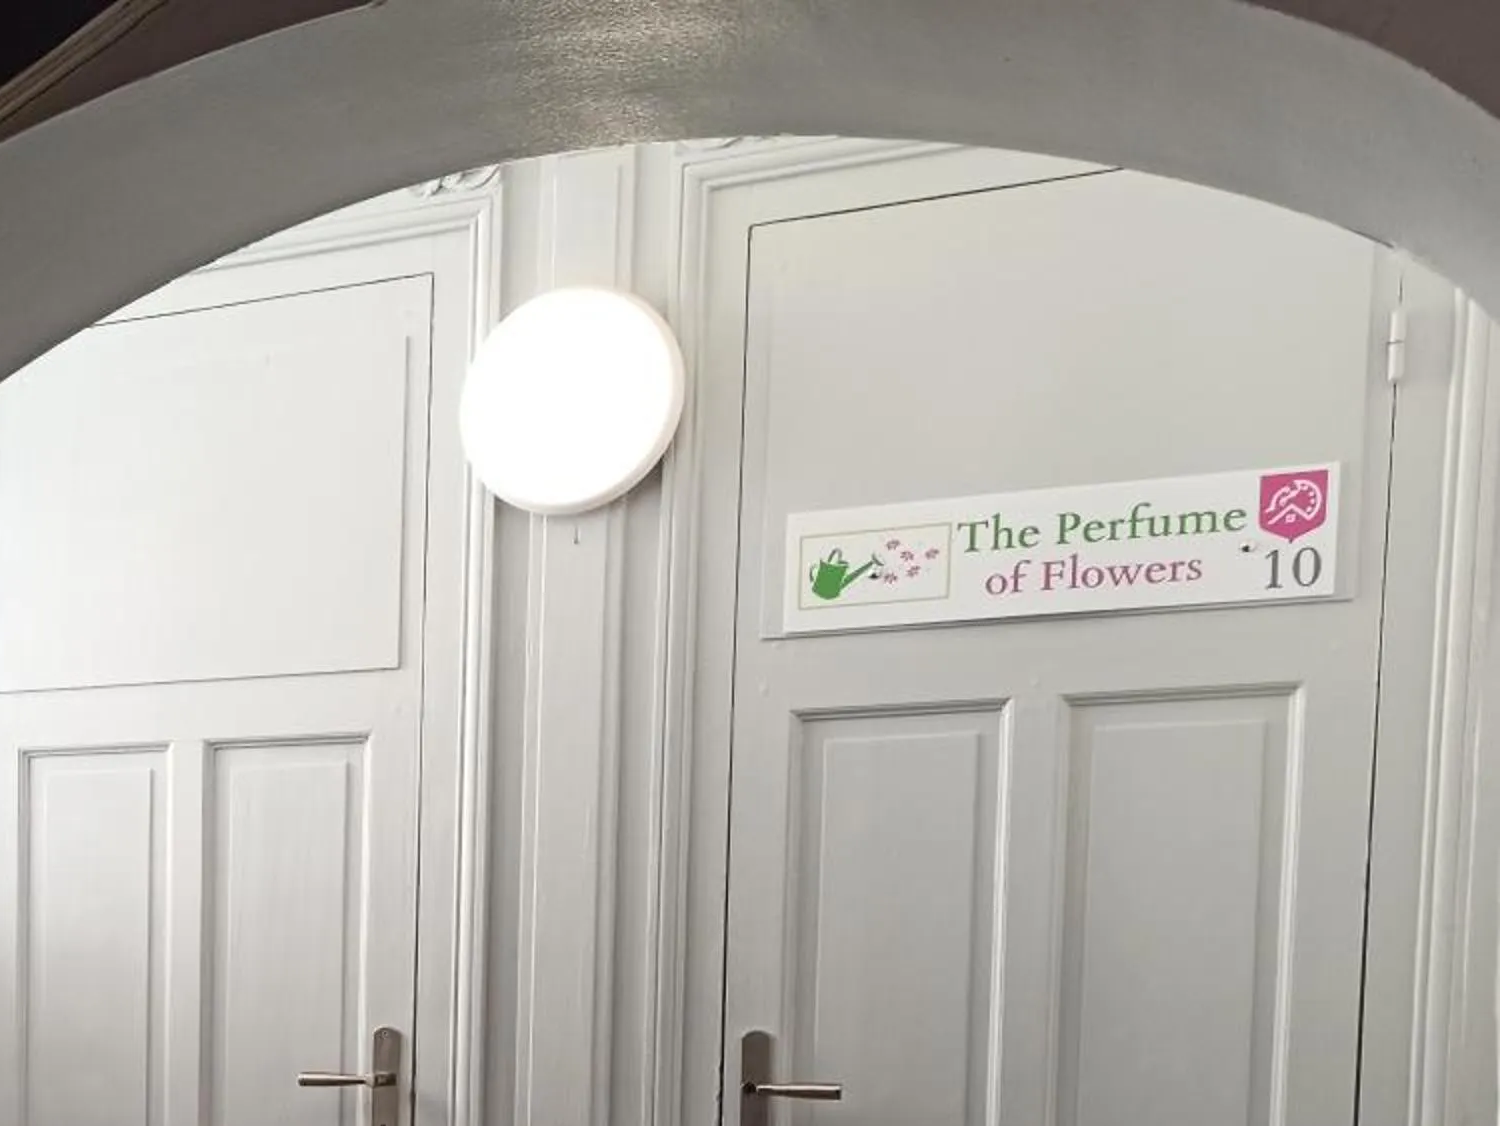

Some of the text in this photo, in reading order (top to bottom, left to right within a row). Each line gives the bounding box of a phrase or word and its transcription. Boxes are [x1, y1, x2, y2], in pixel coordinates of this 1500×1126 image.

[958, 502, 1248, 552] The Perfume
[985, 553, 1203, 595] of Flowers
[1264, 546, 1322, 590] 10
